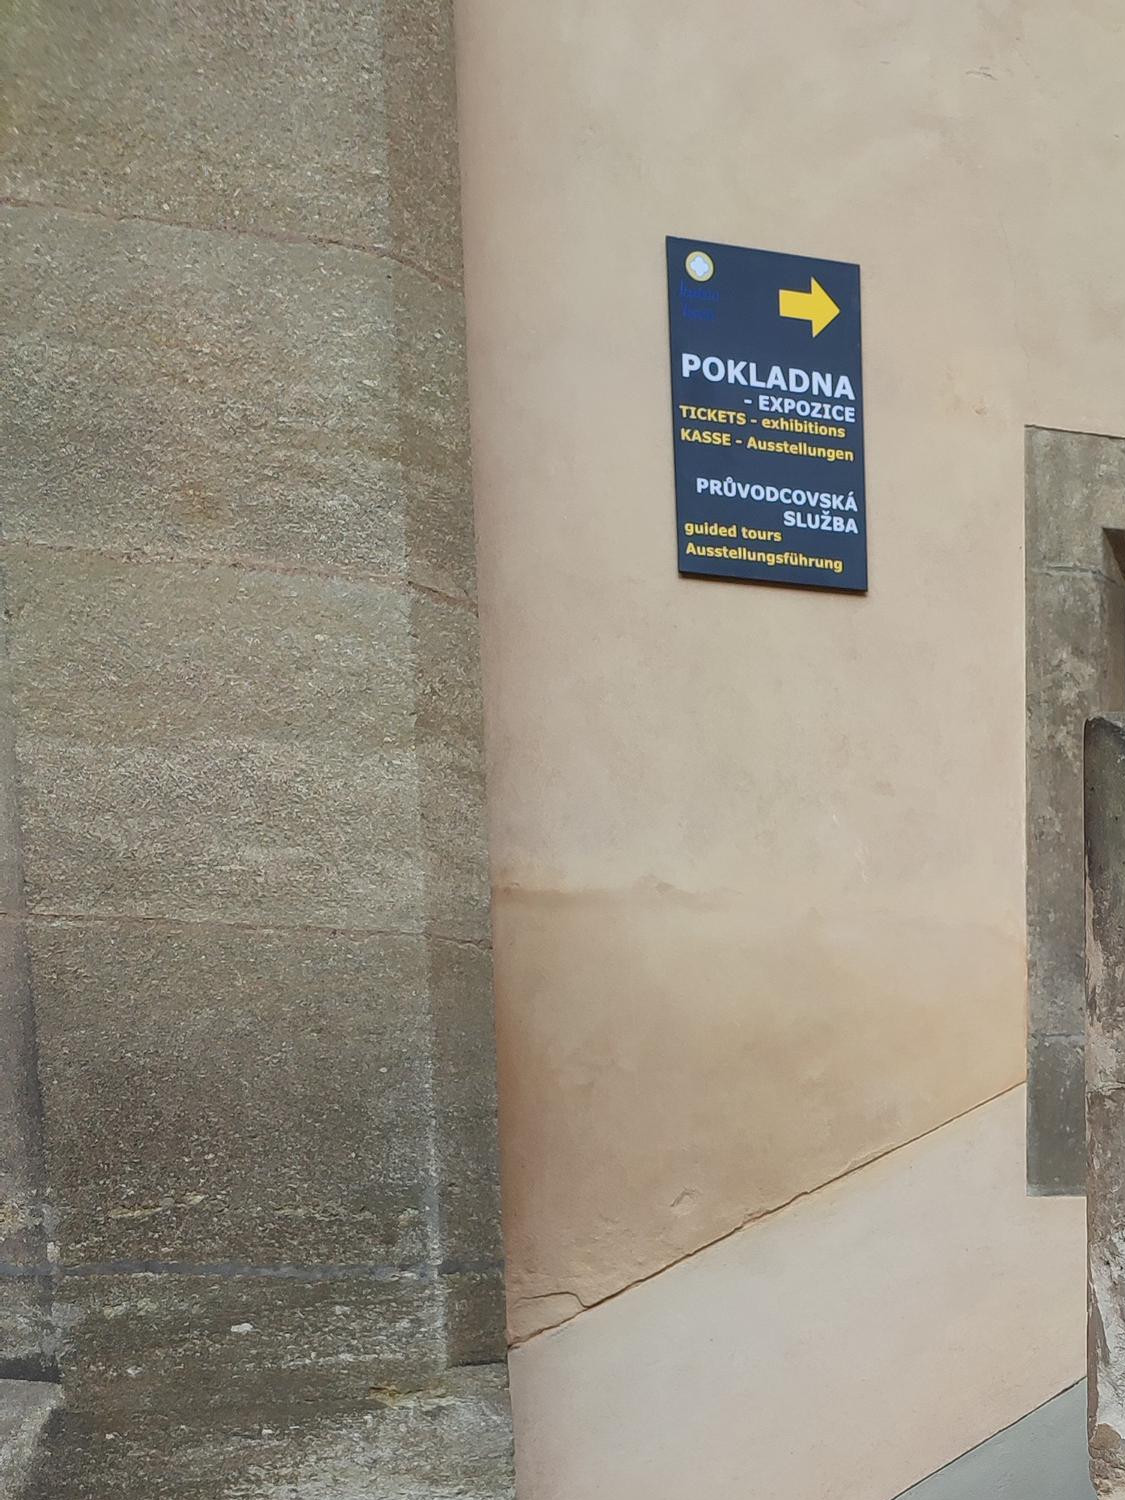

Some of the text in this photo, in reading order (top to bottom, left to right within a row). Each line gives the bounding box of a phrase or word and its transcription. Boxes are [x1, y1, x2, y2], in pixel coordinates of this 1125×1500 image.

[681, 353, 855, 400] POKLADNA
[680, 405, 746, 425] TICKETS
[762, 418, 845, 438] exhibitions
[759, 396, 855, 422] EXPOZICE
[681, 429, 730, 446] KASSE
[747, 437, 853, 462] Ausstellungen
[697, 477, 858, 512] PRŮVODCOVSKÁ
[685, 522, 781, 542] guided tours
[783, 510, 858, 534] SLUŽBA
[686, 543, 843, 573] Ausstellungsführung
